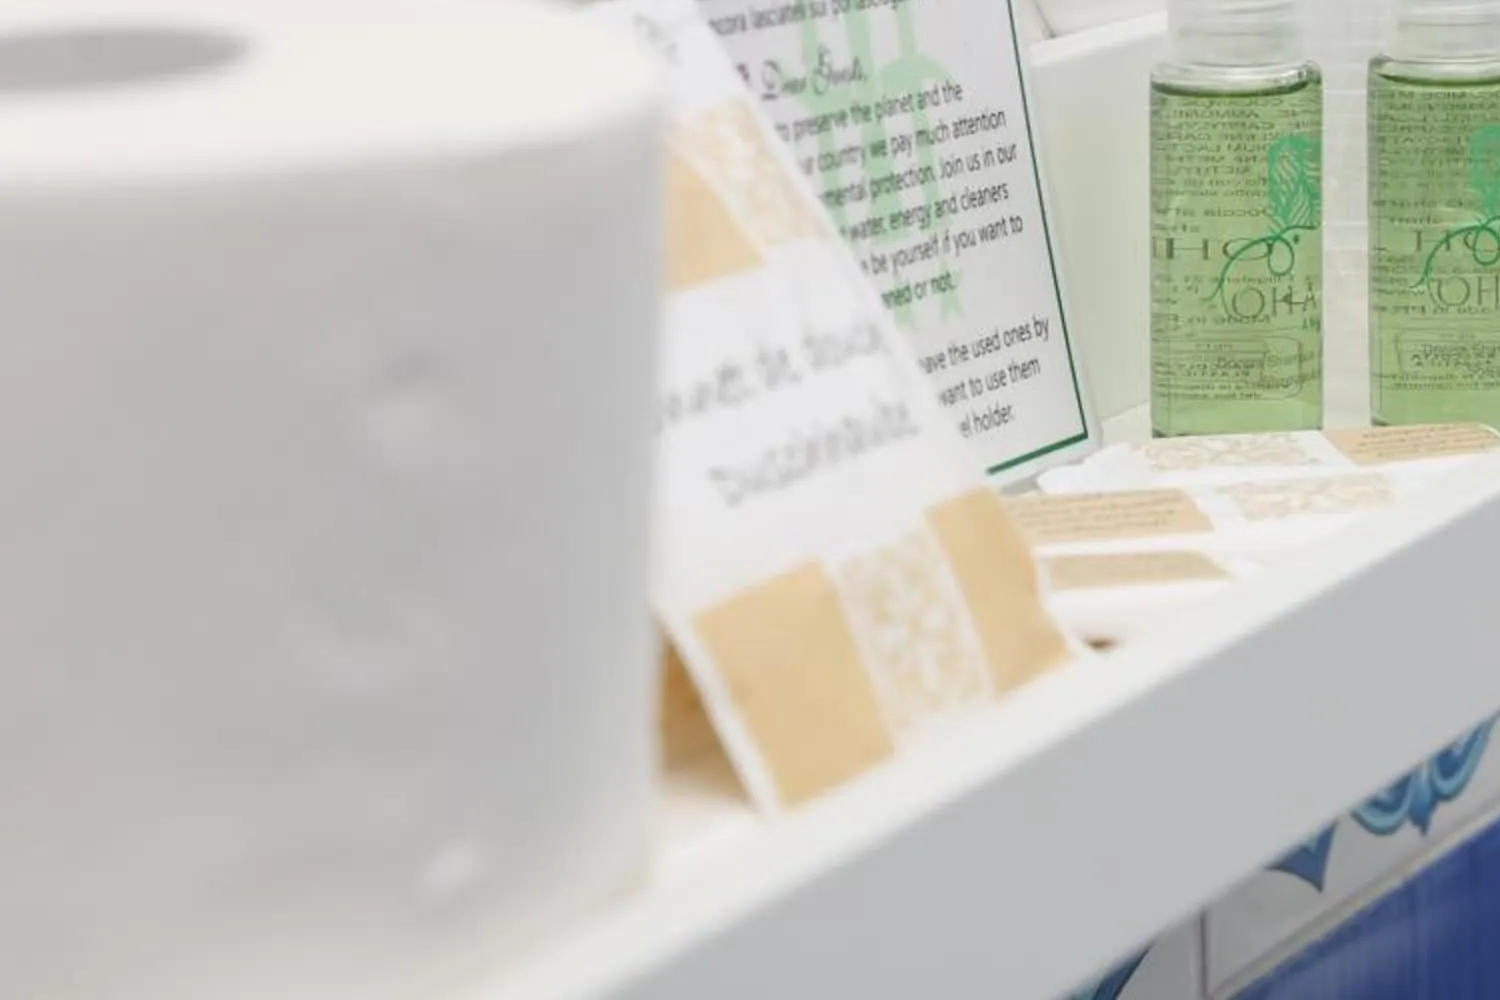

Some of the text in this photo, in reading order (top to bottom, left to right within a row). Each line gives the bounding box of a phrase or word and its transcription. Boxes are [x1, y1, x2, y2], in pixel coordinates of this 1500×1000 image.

[793, 109, 849, 143] preserve
[850, 103, 872, 125] the
[874, 92, 914, 124] planet
[917, 82, 940, 110] and
[942, 80, 963, 104] the
[818, 146, 866, 174] country
[870, 140, 888, 158] we
[890, 134, 913, 158] pay
[915, 119, 949, 147] much
[952, 108, 1007, 140] attention
[940, 155, 964, 180] Join
[967, 153, 981, 173] us
[983, 147, 995, 168] in
[997, 143, 1018, 165] our
[890, 203, 932, 232] energy
[934, 191, 959, 219] and
[961, 182, 1010, 212] cleaners
[870, 213, 1025, 279] be yourself if you want to
[914, 280, 930, 300] or
[948, 342, 969, 366] the
[971, 328, 1001, 359] used
[1003, 322, 1032, 348] ones
[1032, 312, 1050, 342] by
[969, 375, 984, 398] to
[985, 368, 1008, 392] use
[1007, 356, 1042, 385] them
